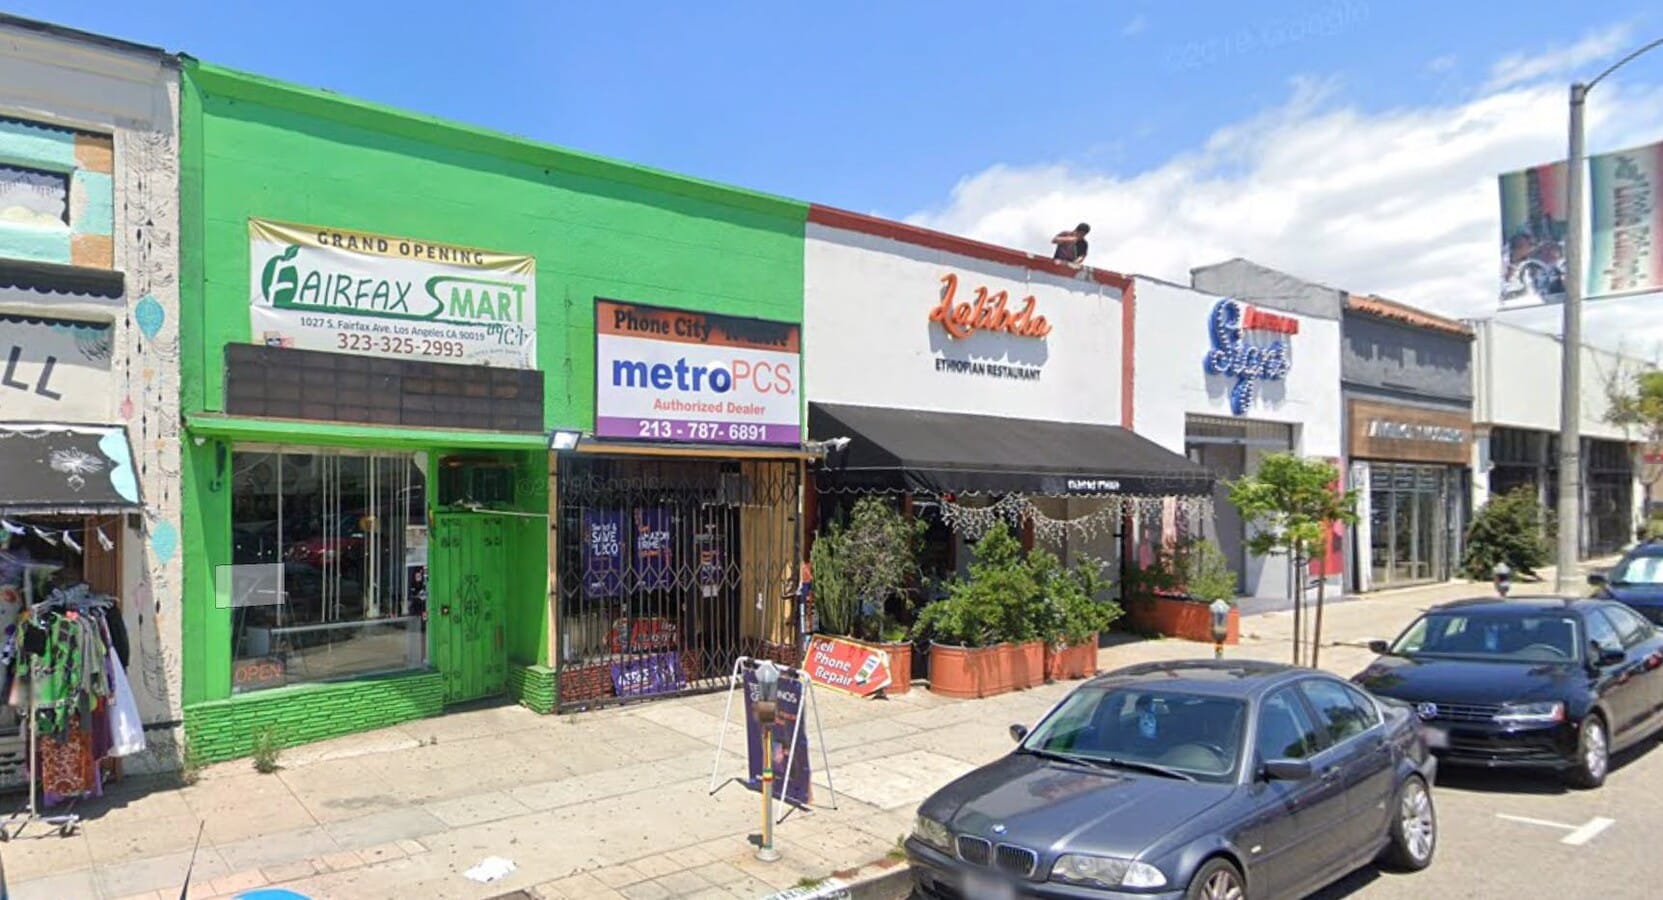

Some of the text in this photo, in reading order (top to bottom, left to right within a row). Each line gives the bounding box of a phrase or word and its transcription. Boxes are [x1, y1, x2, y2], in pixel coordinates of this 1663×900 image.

[317, 231, 485, 266] GRAND OPENING
[425, 275, 526, 323] SMART
[300, 317, 485, 341] 1027 S. Fairfax Ave. Los Angeles CA 90019
[613, 309, 670, 333] Phone
[674, 316, 713, 342] City
[336, 332, 464, 358] 323-325-2993
[935, 358, 1041, 381] ETHIOPIAN RESTAURANT
[653, 398, 766, 416] Authorized Dealer
[639, 420, 672, 438] 213
[728, 424, 767, 441] 6891
[813, 639, 835, 653] Cell
[235, 662, 283, 683] OPEN
[814, 651, 852, 672] Phone
[815, 666, 853, 686] Repair
